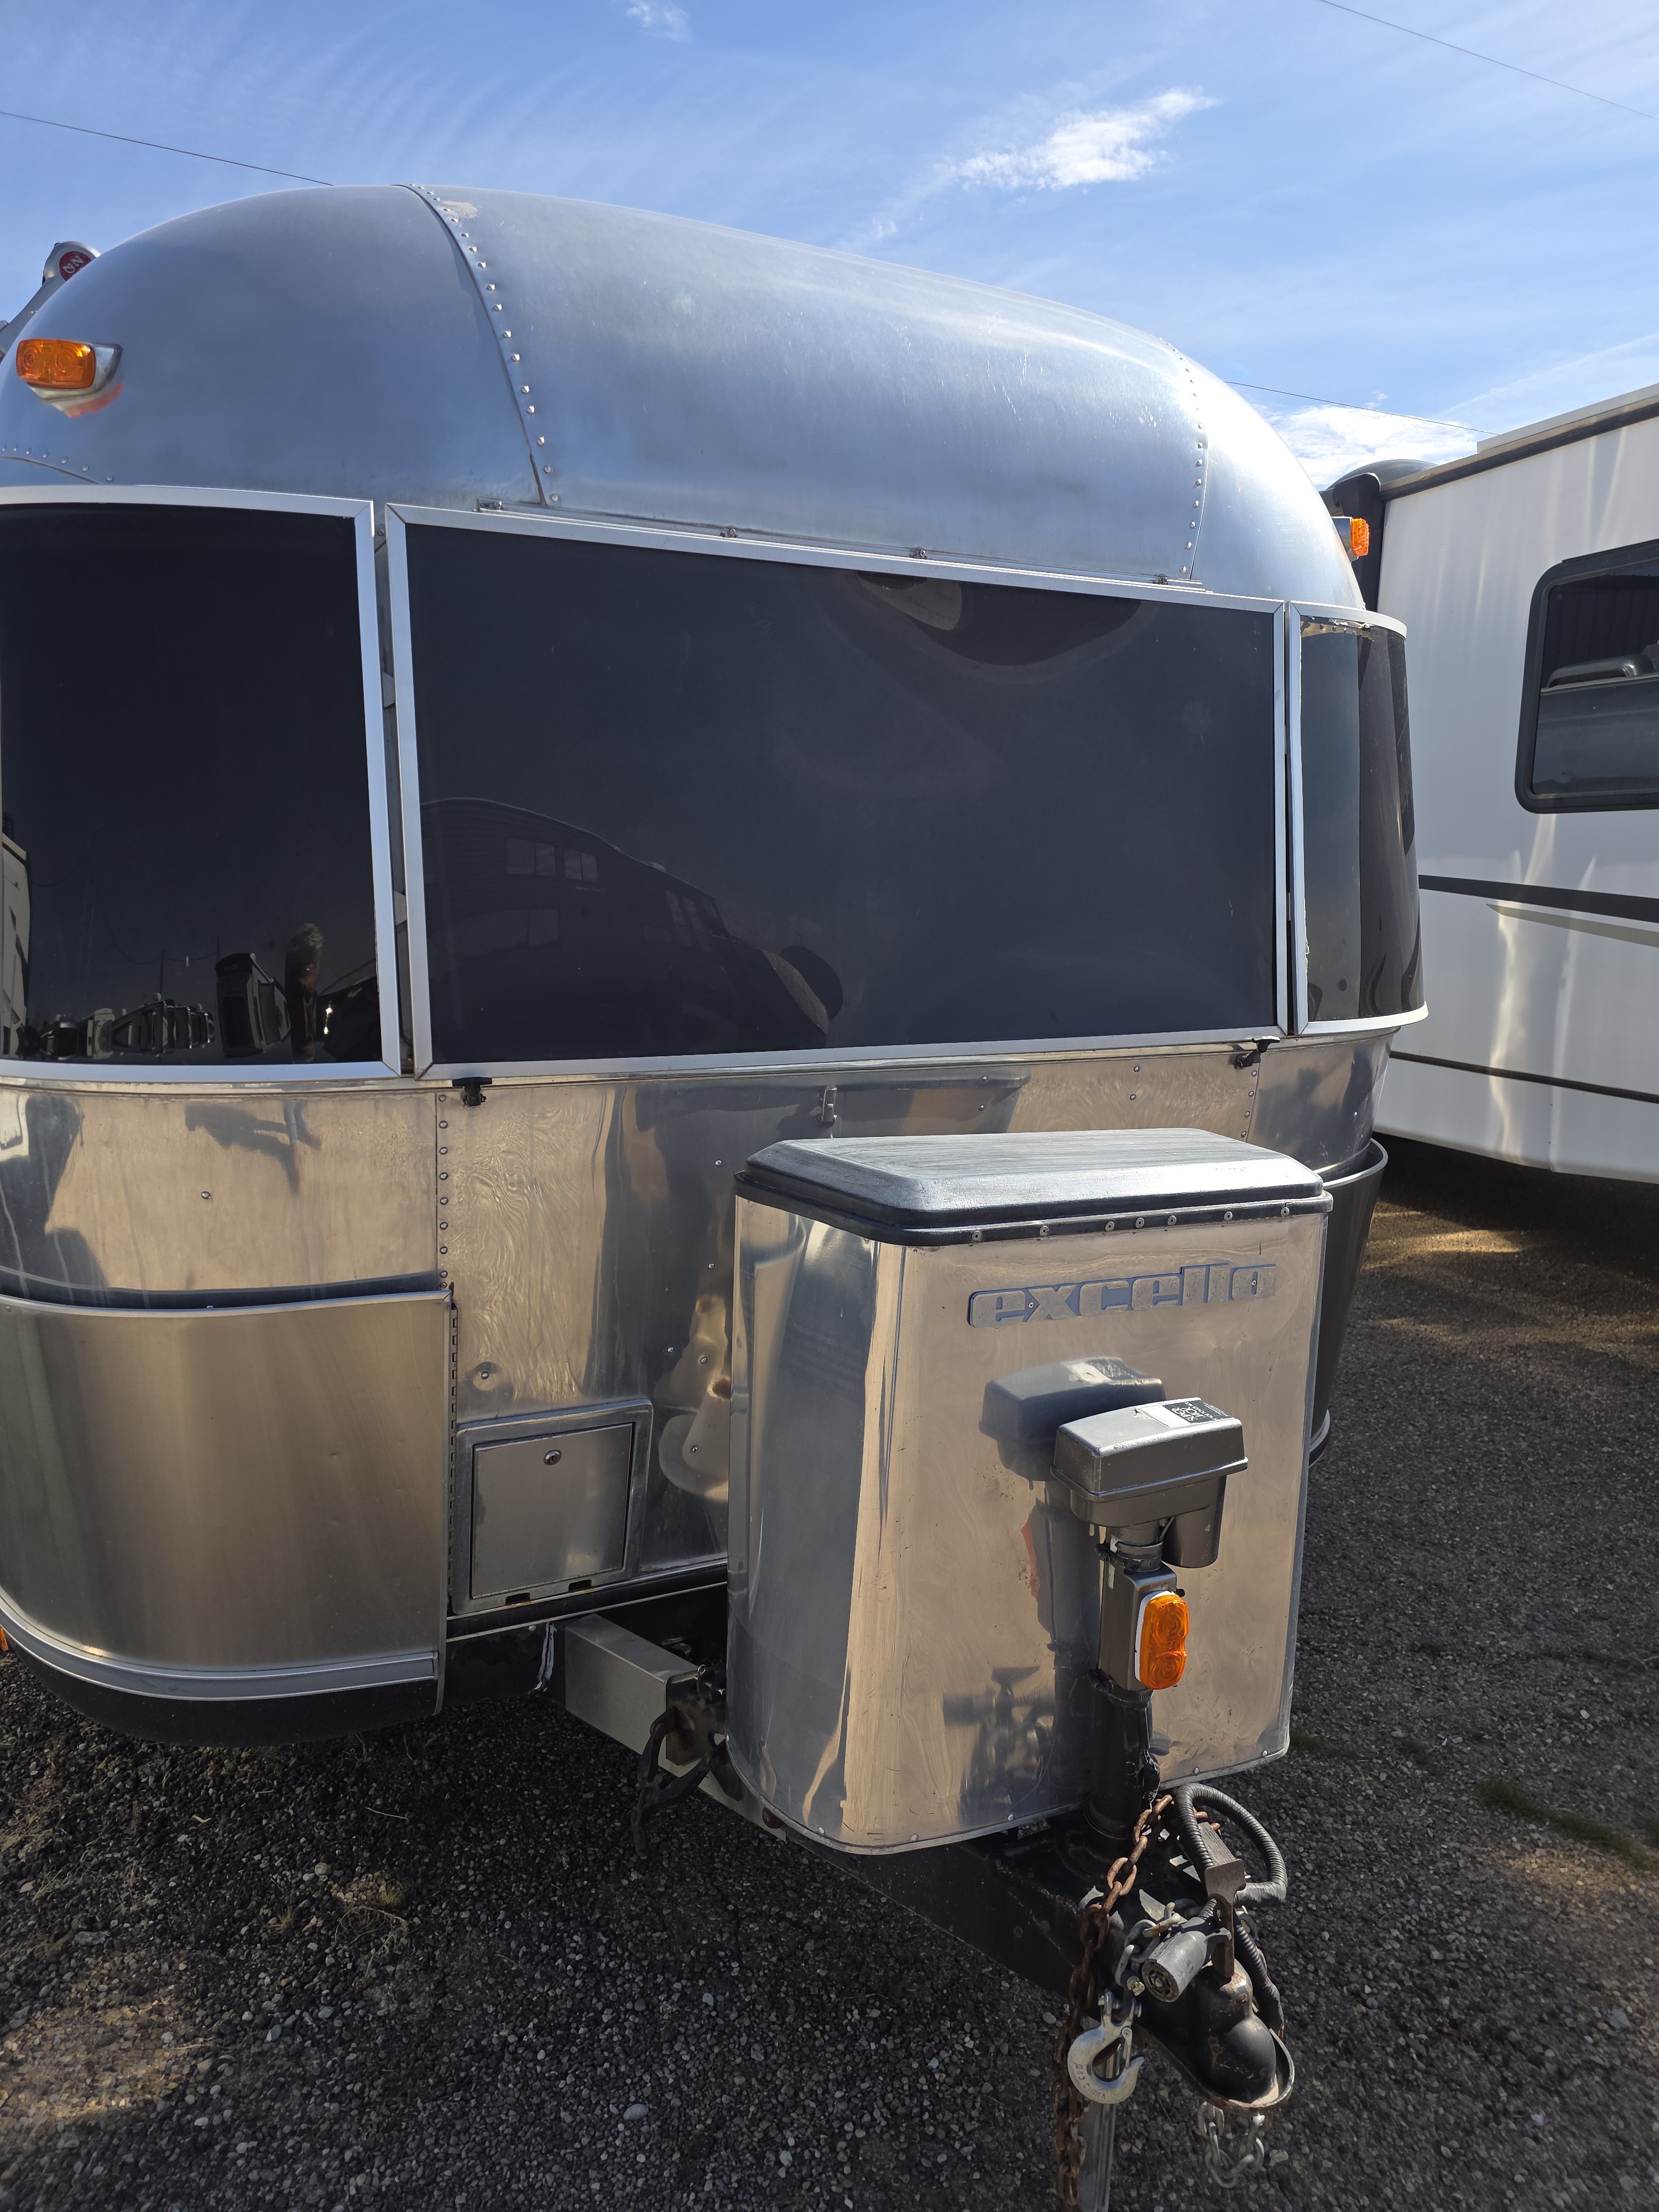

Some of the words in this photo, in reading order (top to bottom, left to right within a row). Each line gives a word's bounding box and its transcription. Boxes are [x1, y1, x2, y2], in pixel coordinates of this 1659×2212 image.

[1171, 1407, 1198, 1421] SUPER
[1181, 1406, 1205, 1417] JACK
[1083, 2083, 1107, 2100] CHINA
